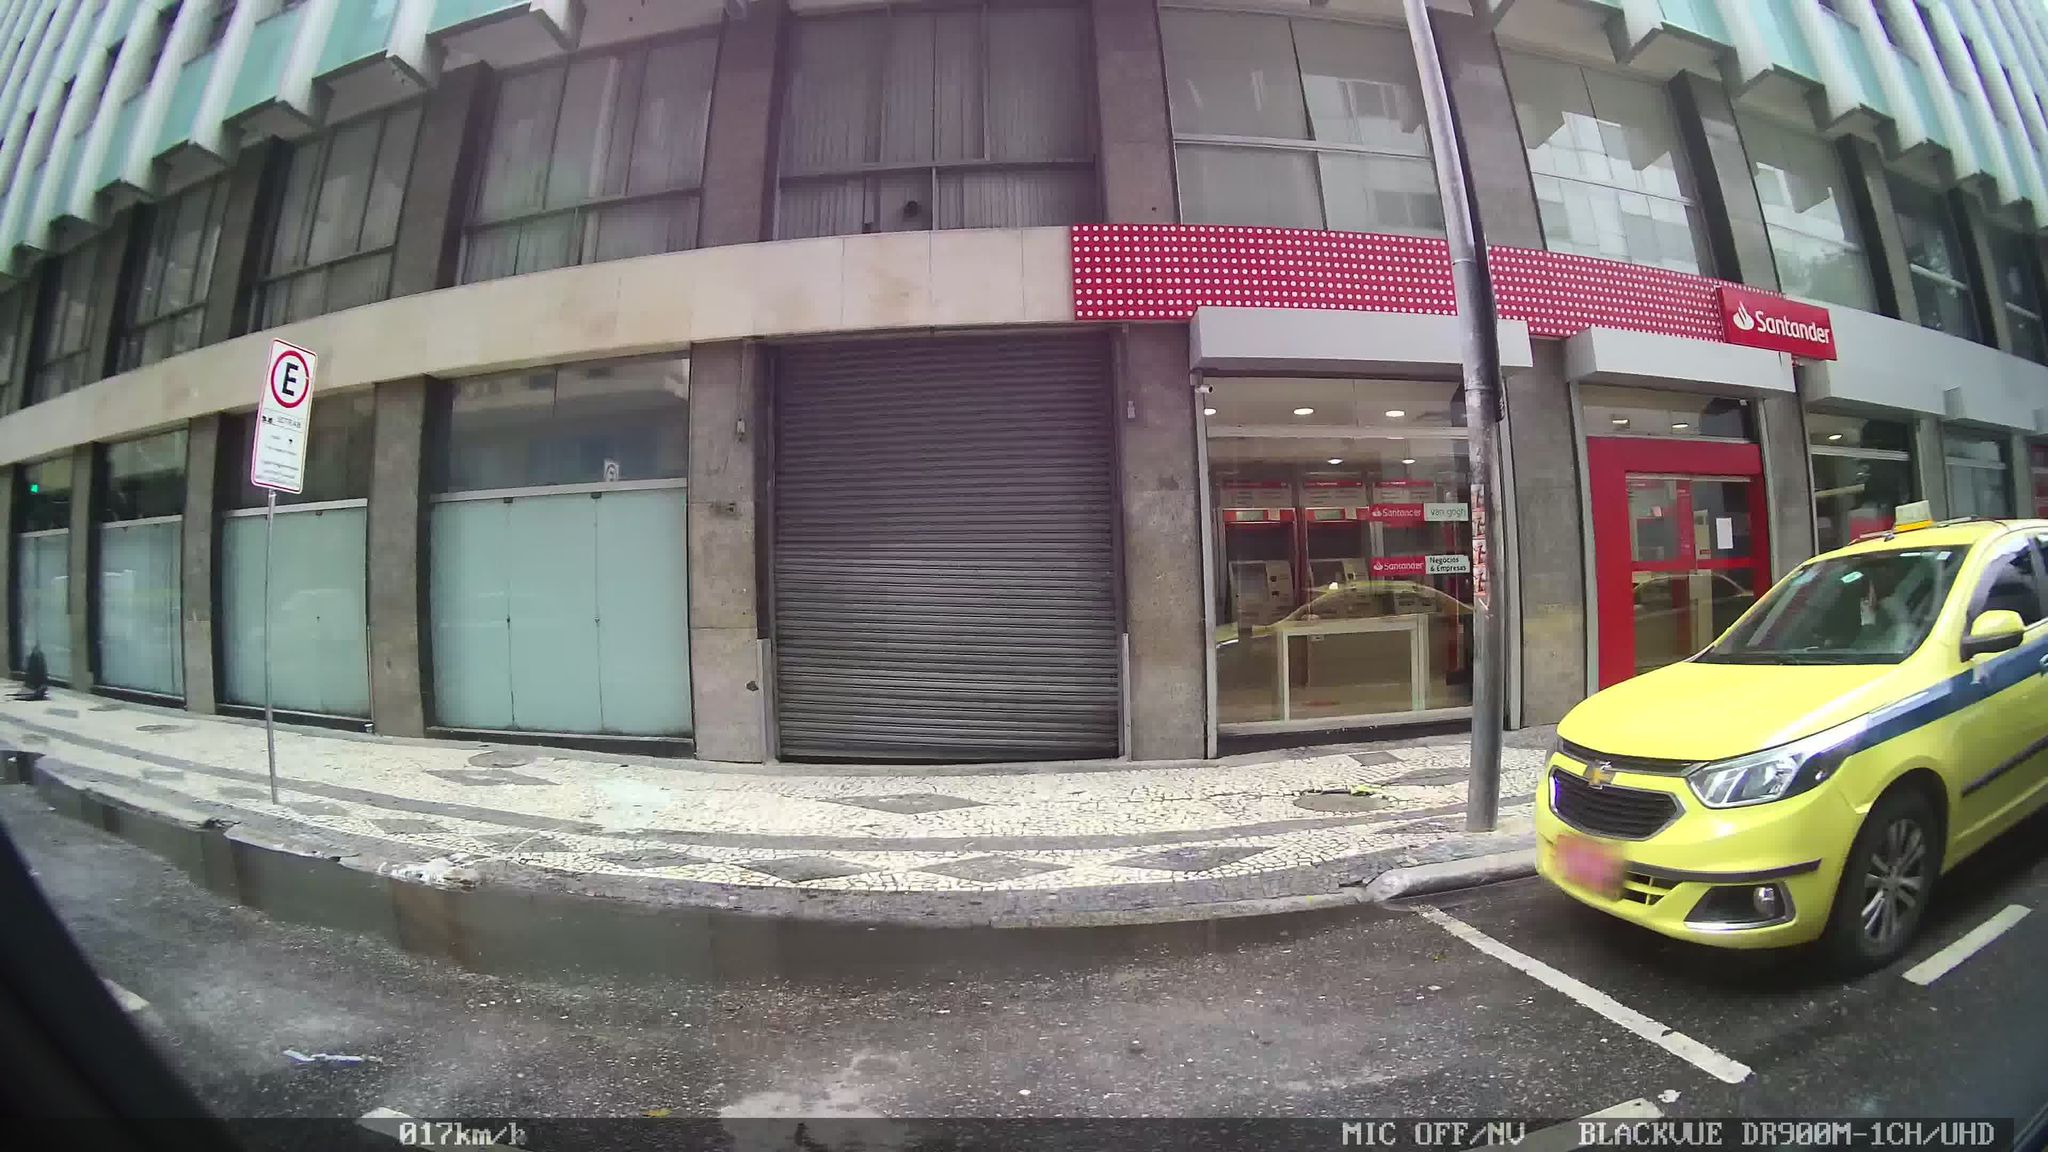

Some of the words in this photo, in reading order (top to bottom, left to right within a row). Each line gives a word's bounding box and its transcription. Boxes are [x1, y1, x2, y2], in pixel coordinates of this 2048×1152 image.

[1754, 310, 1830, 344] Santander
[281, 361, 299, 397] E
[1429, 556, 1459, 565] Negócios
[1437, 564, 1467, 573] Empresas
